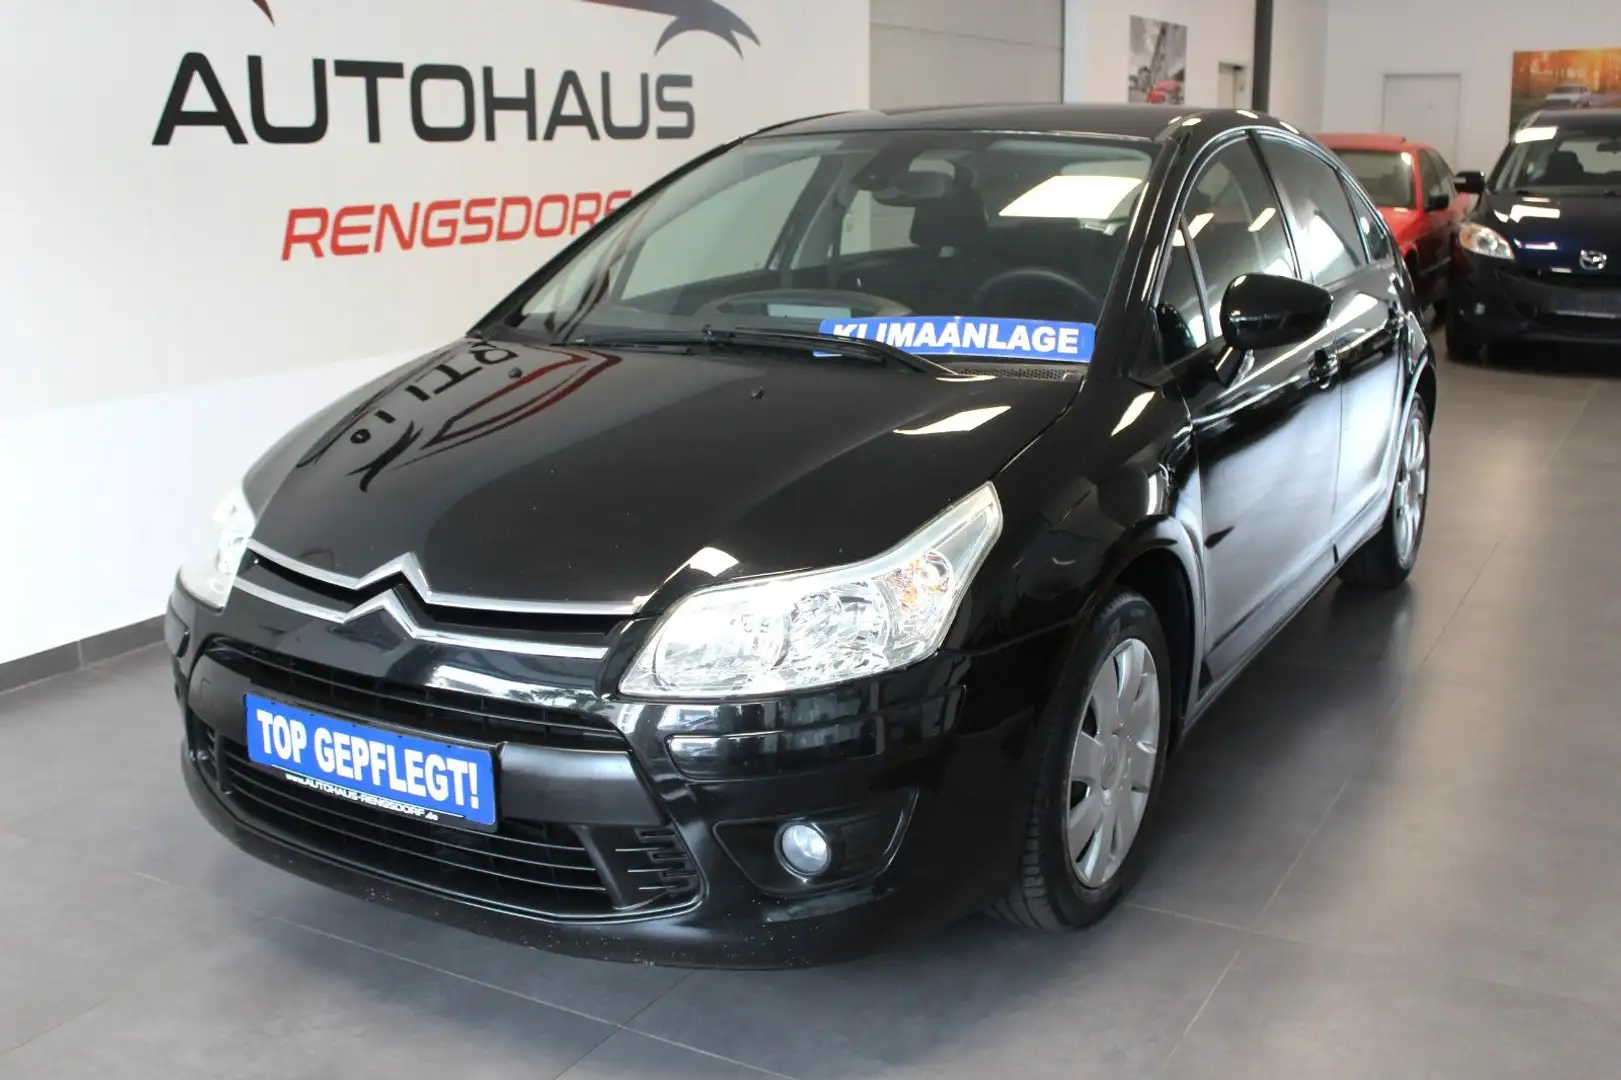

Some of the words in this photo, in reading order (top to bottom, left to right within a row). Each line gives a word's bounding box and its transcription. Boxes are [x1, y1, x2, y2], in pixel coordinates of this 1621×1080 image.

[151, 51, 696, 145] AUTOHAUS
[256, 709, 307, 763] TOP
[314, 727, 479, 810] GEPFLEGT!
